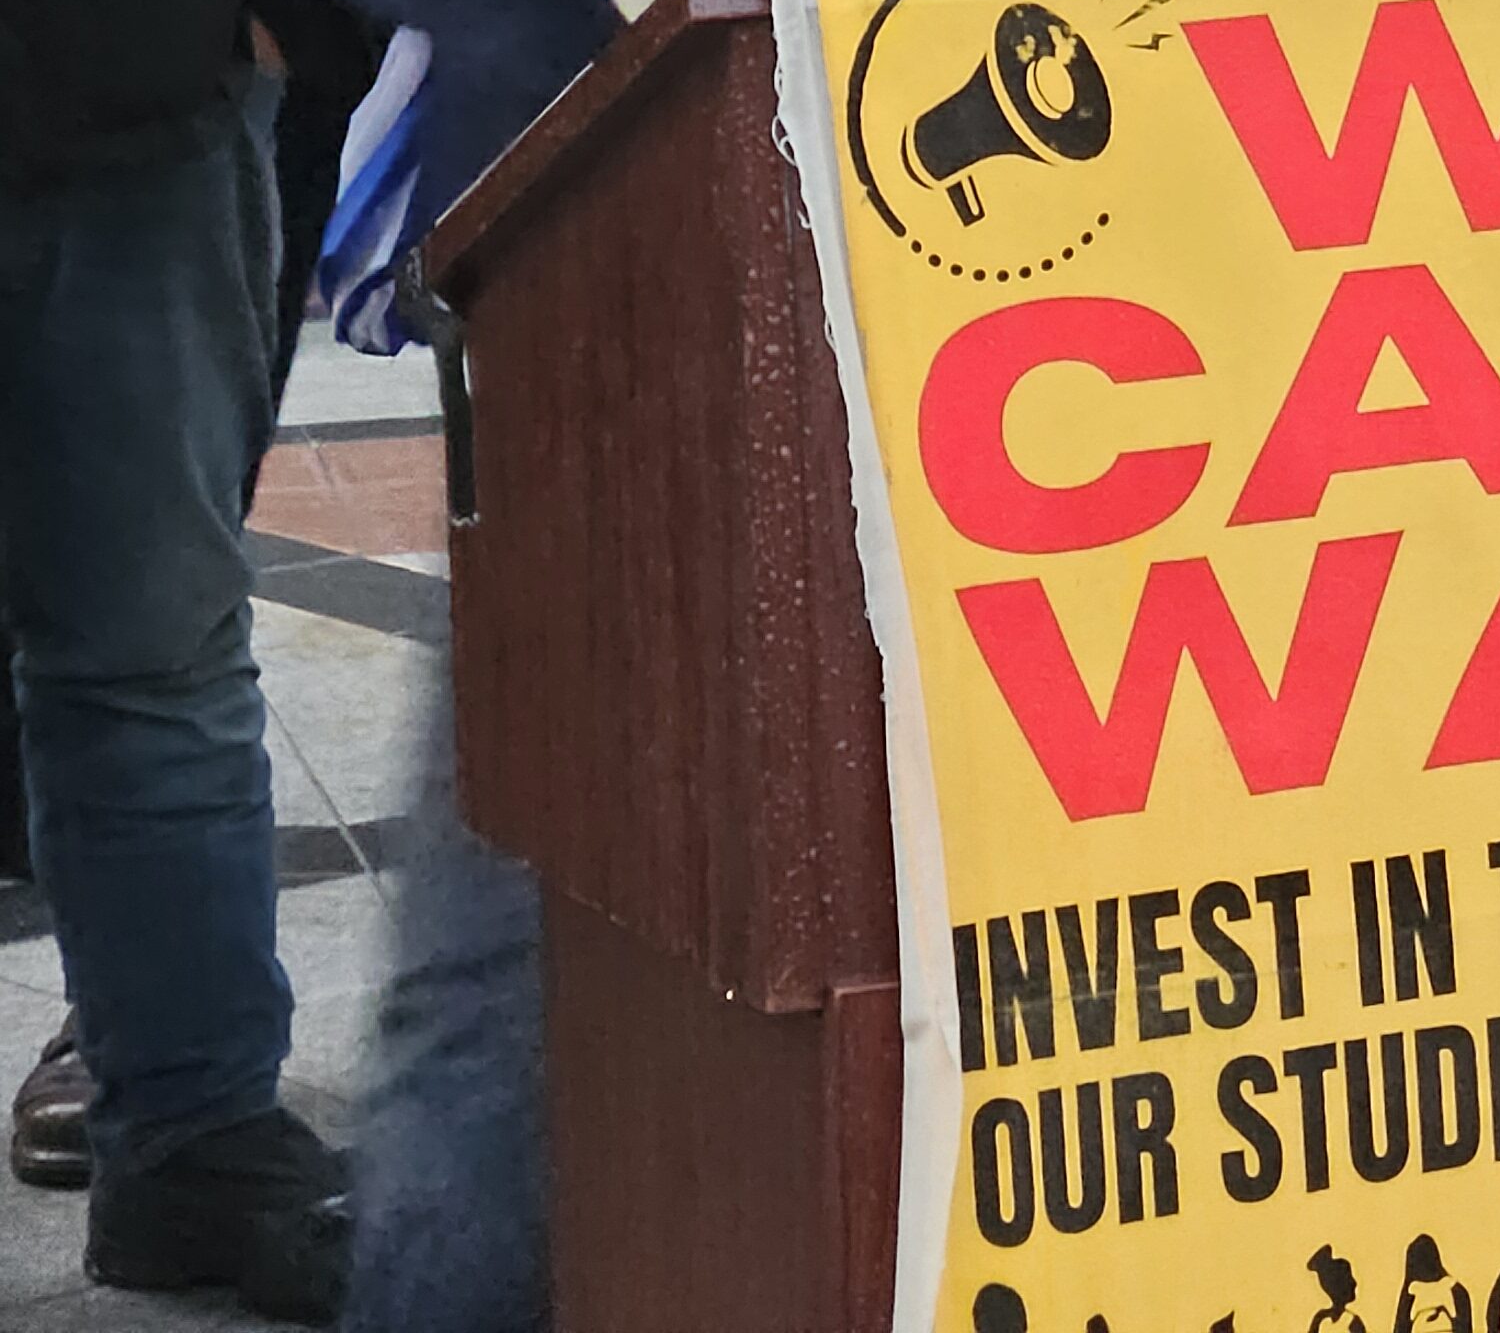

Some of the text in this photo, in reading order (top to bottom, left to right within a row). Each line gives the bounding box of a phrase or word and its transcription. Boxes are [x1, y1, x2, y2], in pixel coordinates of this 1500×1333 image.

[953, 870, 1311, 1073] INVEST
[1351, 850, 1456, 1006] IN
[972, 1073, 1179, 1248] OUR
